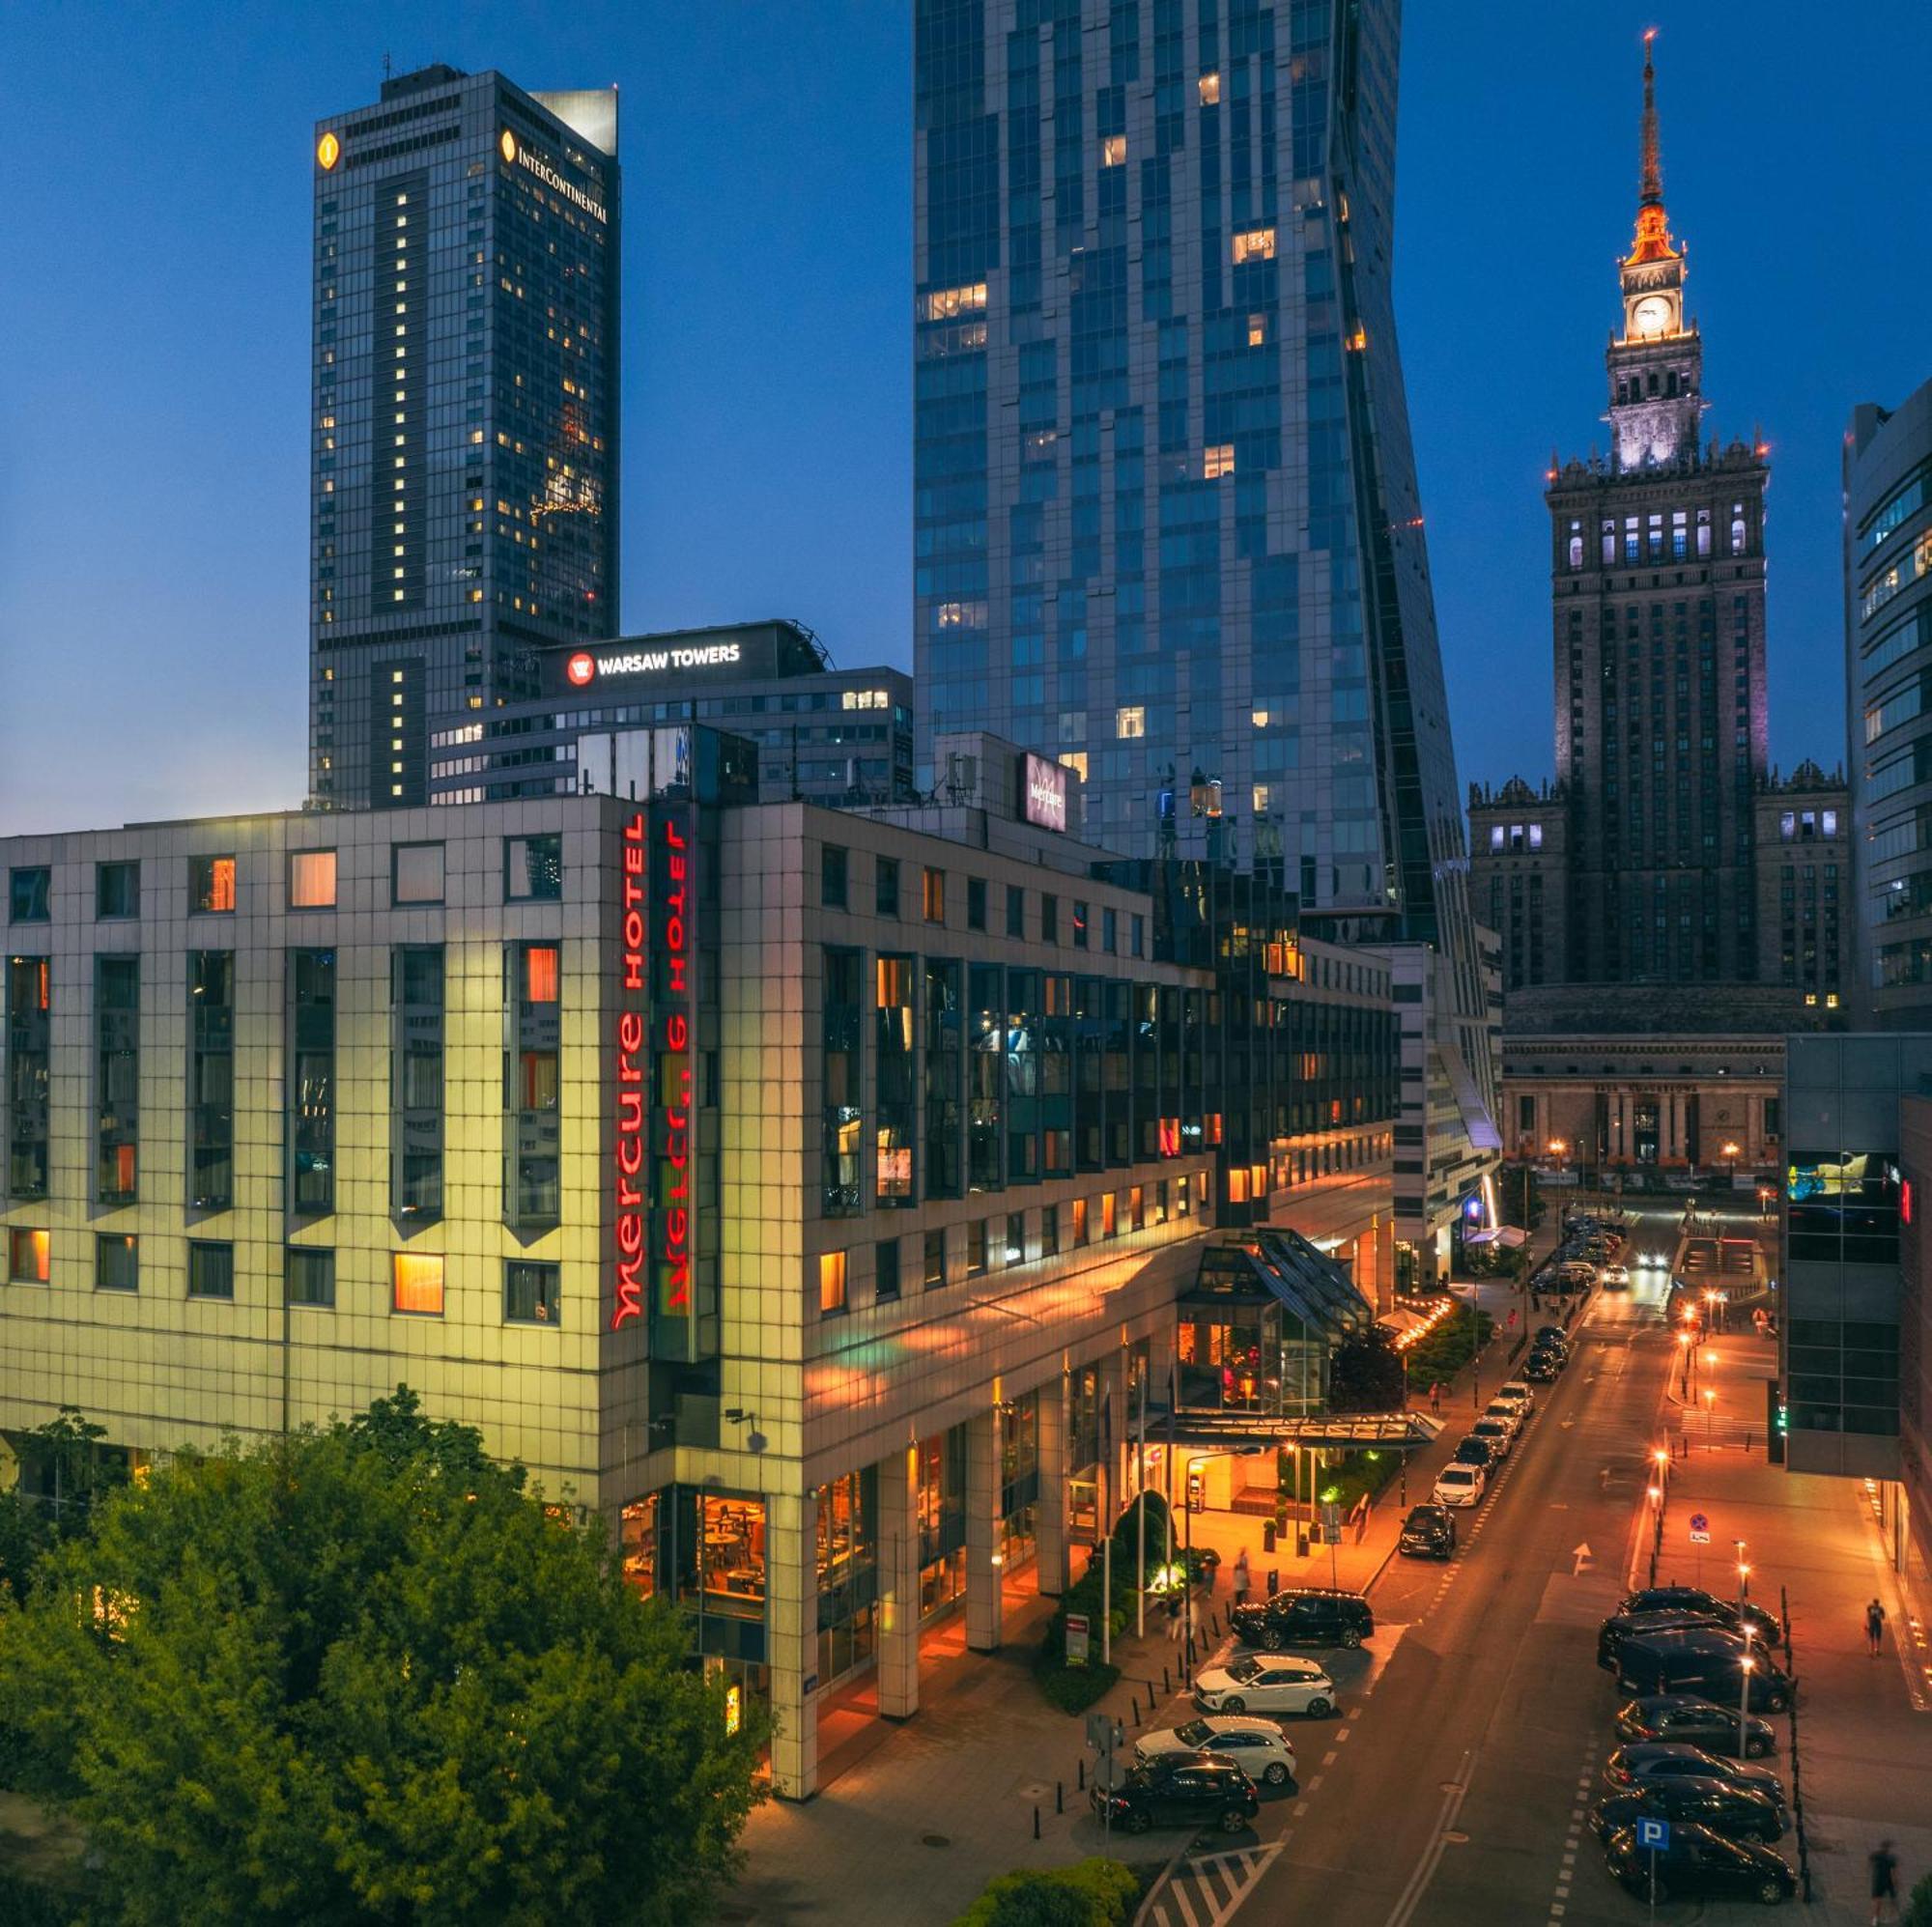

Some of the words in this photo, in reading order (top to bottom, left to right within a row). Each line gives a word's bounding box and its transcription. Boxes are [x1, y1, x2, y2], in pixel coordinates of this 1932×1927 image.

[597, 651, 668, 676] WARSAW
[670, 643, 741, 668] TOWERS
[624, 813, 643, 989] HOTEL
[1644, 1822, 1662, 1844] P
